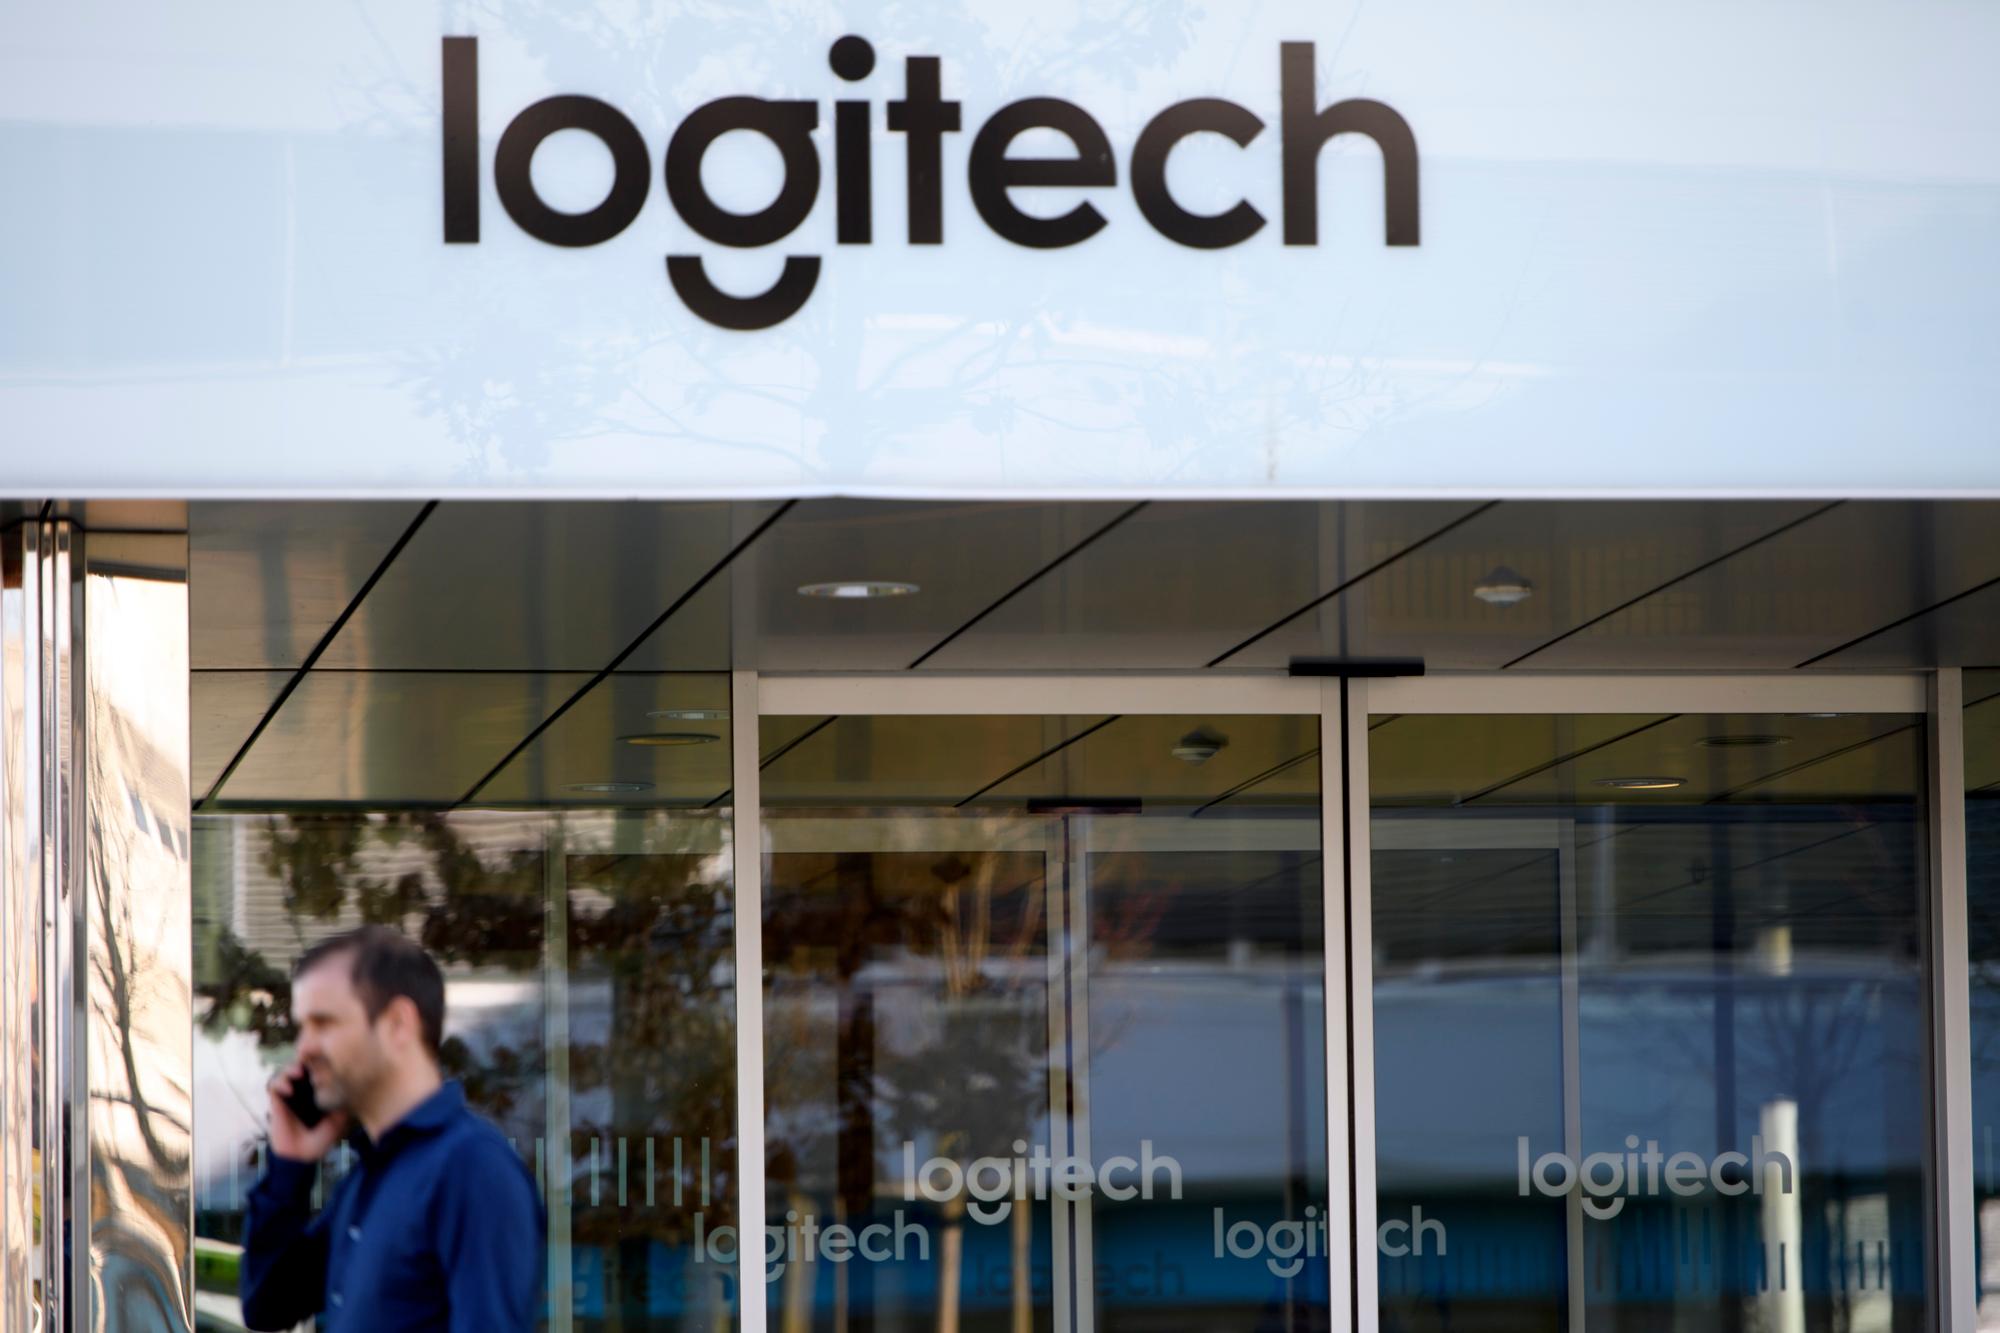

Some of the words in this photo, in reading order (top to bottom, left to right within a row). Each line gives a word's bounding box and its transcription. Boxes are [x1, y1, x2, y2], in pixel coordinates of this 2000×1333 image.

[442, 34, 1420, 330] logitech
[903, 1138, 1183, 1225] logitech
[1518, 1134, 1793, 1220] logitech
